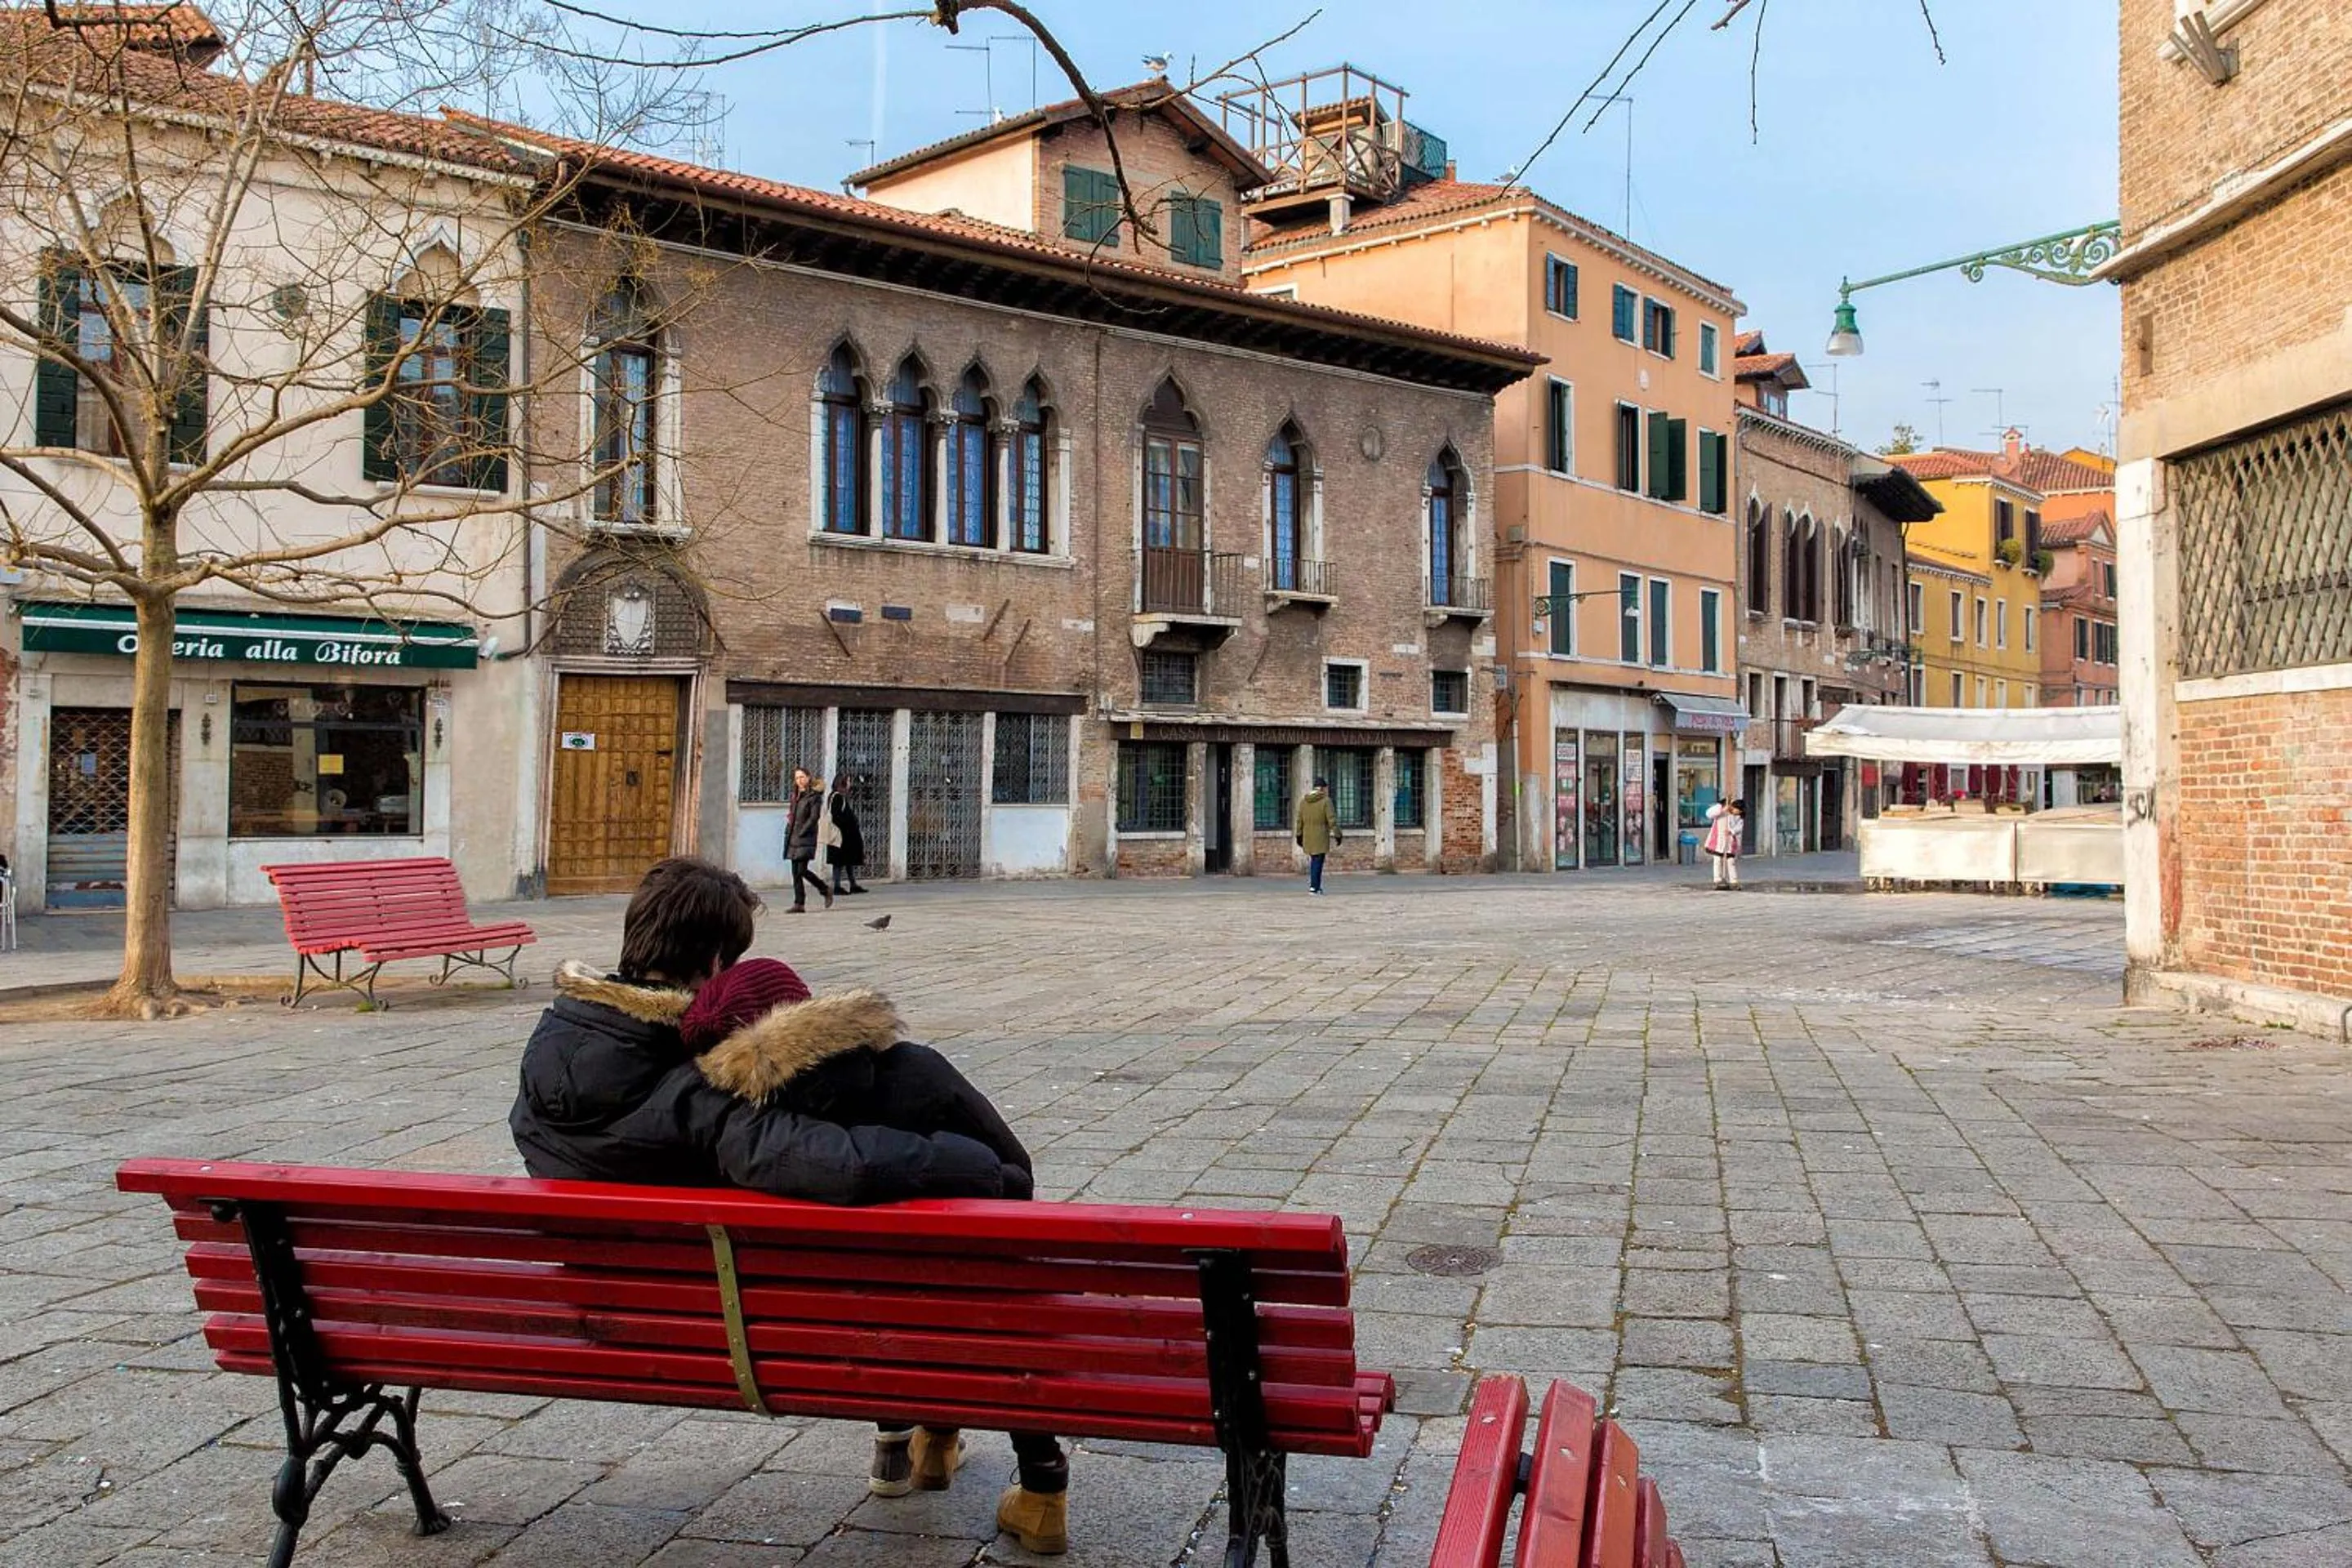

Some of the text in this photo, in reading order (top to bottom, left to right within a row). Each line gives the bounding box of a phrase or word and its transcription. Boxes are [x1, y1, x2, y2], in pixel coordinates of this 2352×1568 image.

[117, 635, 402, 666] Oeria alla Bifora
[1159, 727, 1393, 746] CASSA DI RISPARMIO DI VENEZIA
